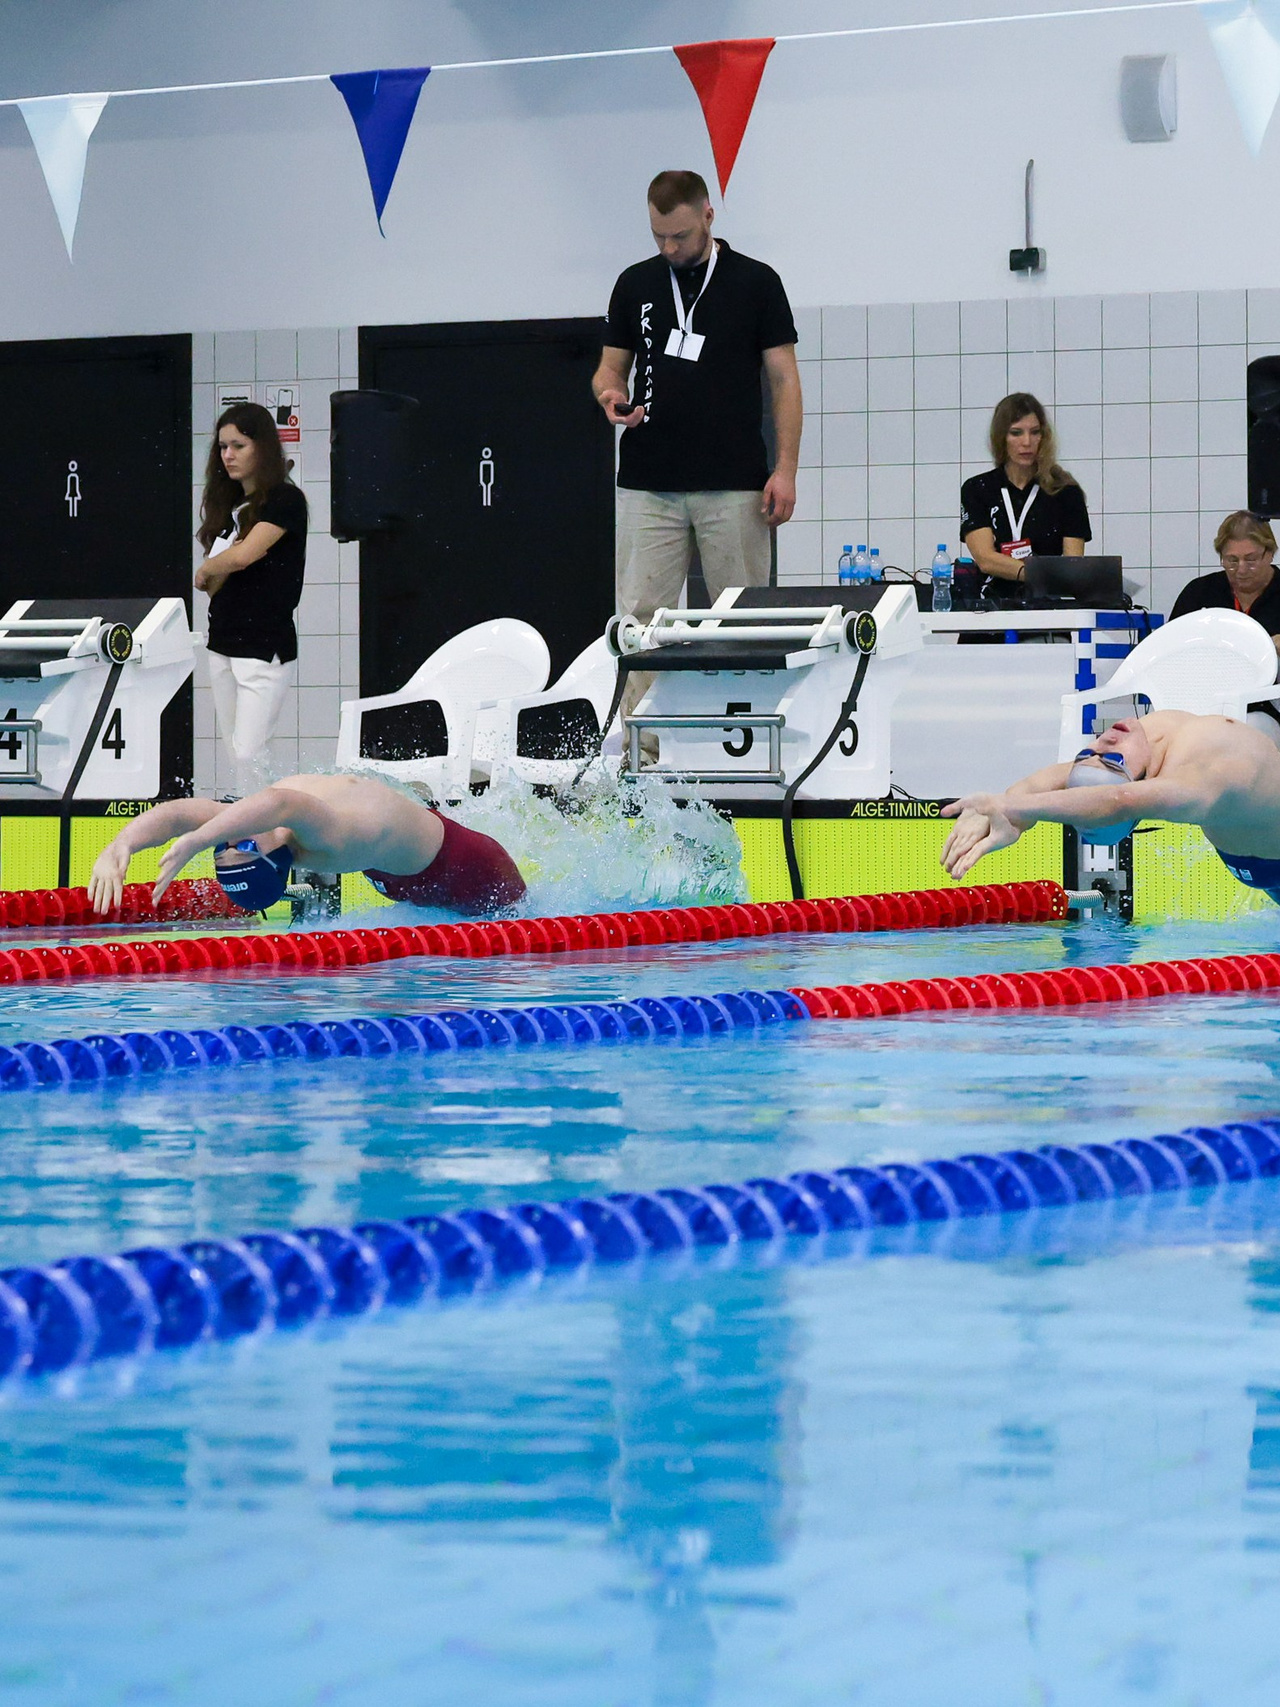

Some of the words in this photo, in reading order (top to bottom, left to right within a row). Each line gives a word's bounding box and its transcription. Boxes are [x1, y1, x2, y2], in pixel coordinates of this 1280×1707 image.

[102, 708, 126, 759] 4
[722, 702, 753, 757] 5
[839, 701, 858, 756] 5
[851, 802, 941, 817] ALGE-TIMING
